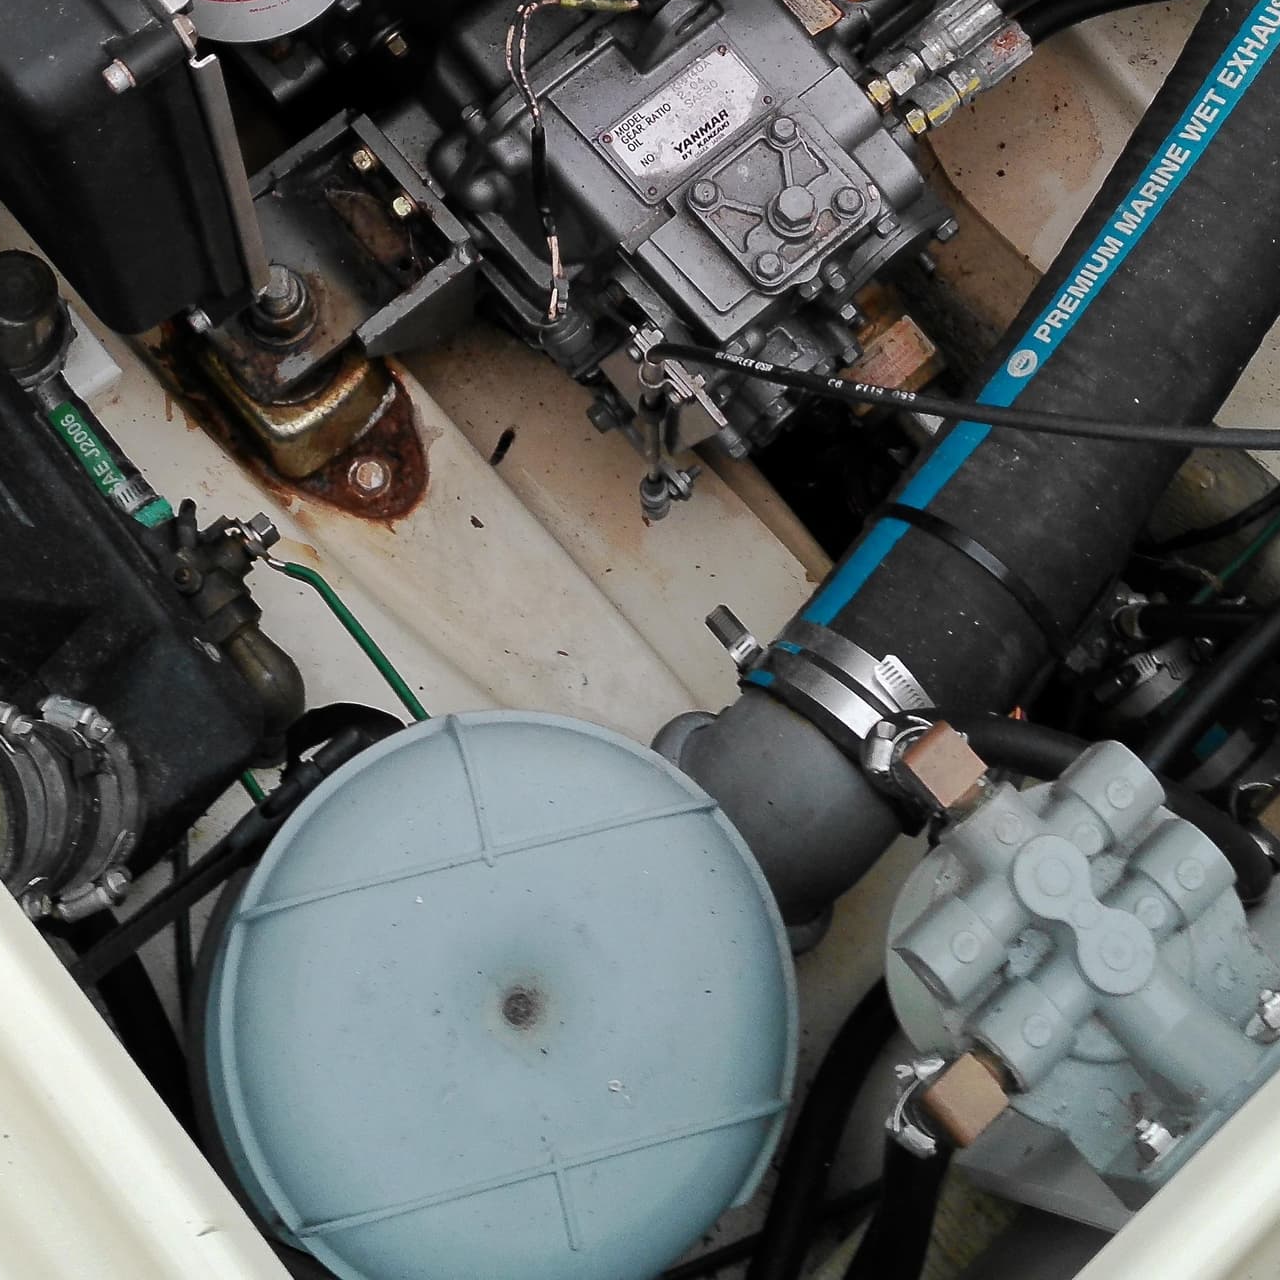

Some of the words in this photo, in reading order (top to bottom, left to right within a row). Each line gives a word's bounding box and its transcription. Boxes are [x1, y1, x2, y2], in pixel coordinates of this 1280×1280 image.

[614, 111, 645, 137] MODEL
[621, 124, 645, 145] GEAR
[645, 103, 672, 126] RATIO
[674, 109, 729, 154] YANMAR
[681, 149, 694, 160] BY
[697, 121, 730, 148] KANZAKI
[627, 139, 644, 152] OIL
[1033, 236, 1124, 343] PREMIUM
[1116, 143, 1191, 235] MARINE
[1179, 88, 1228, 142] WET
[60, 413, 100, 457] J2006
